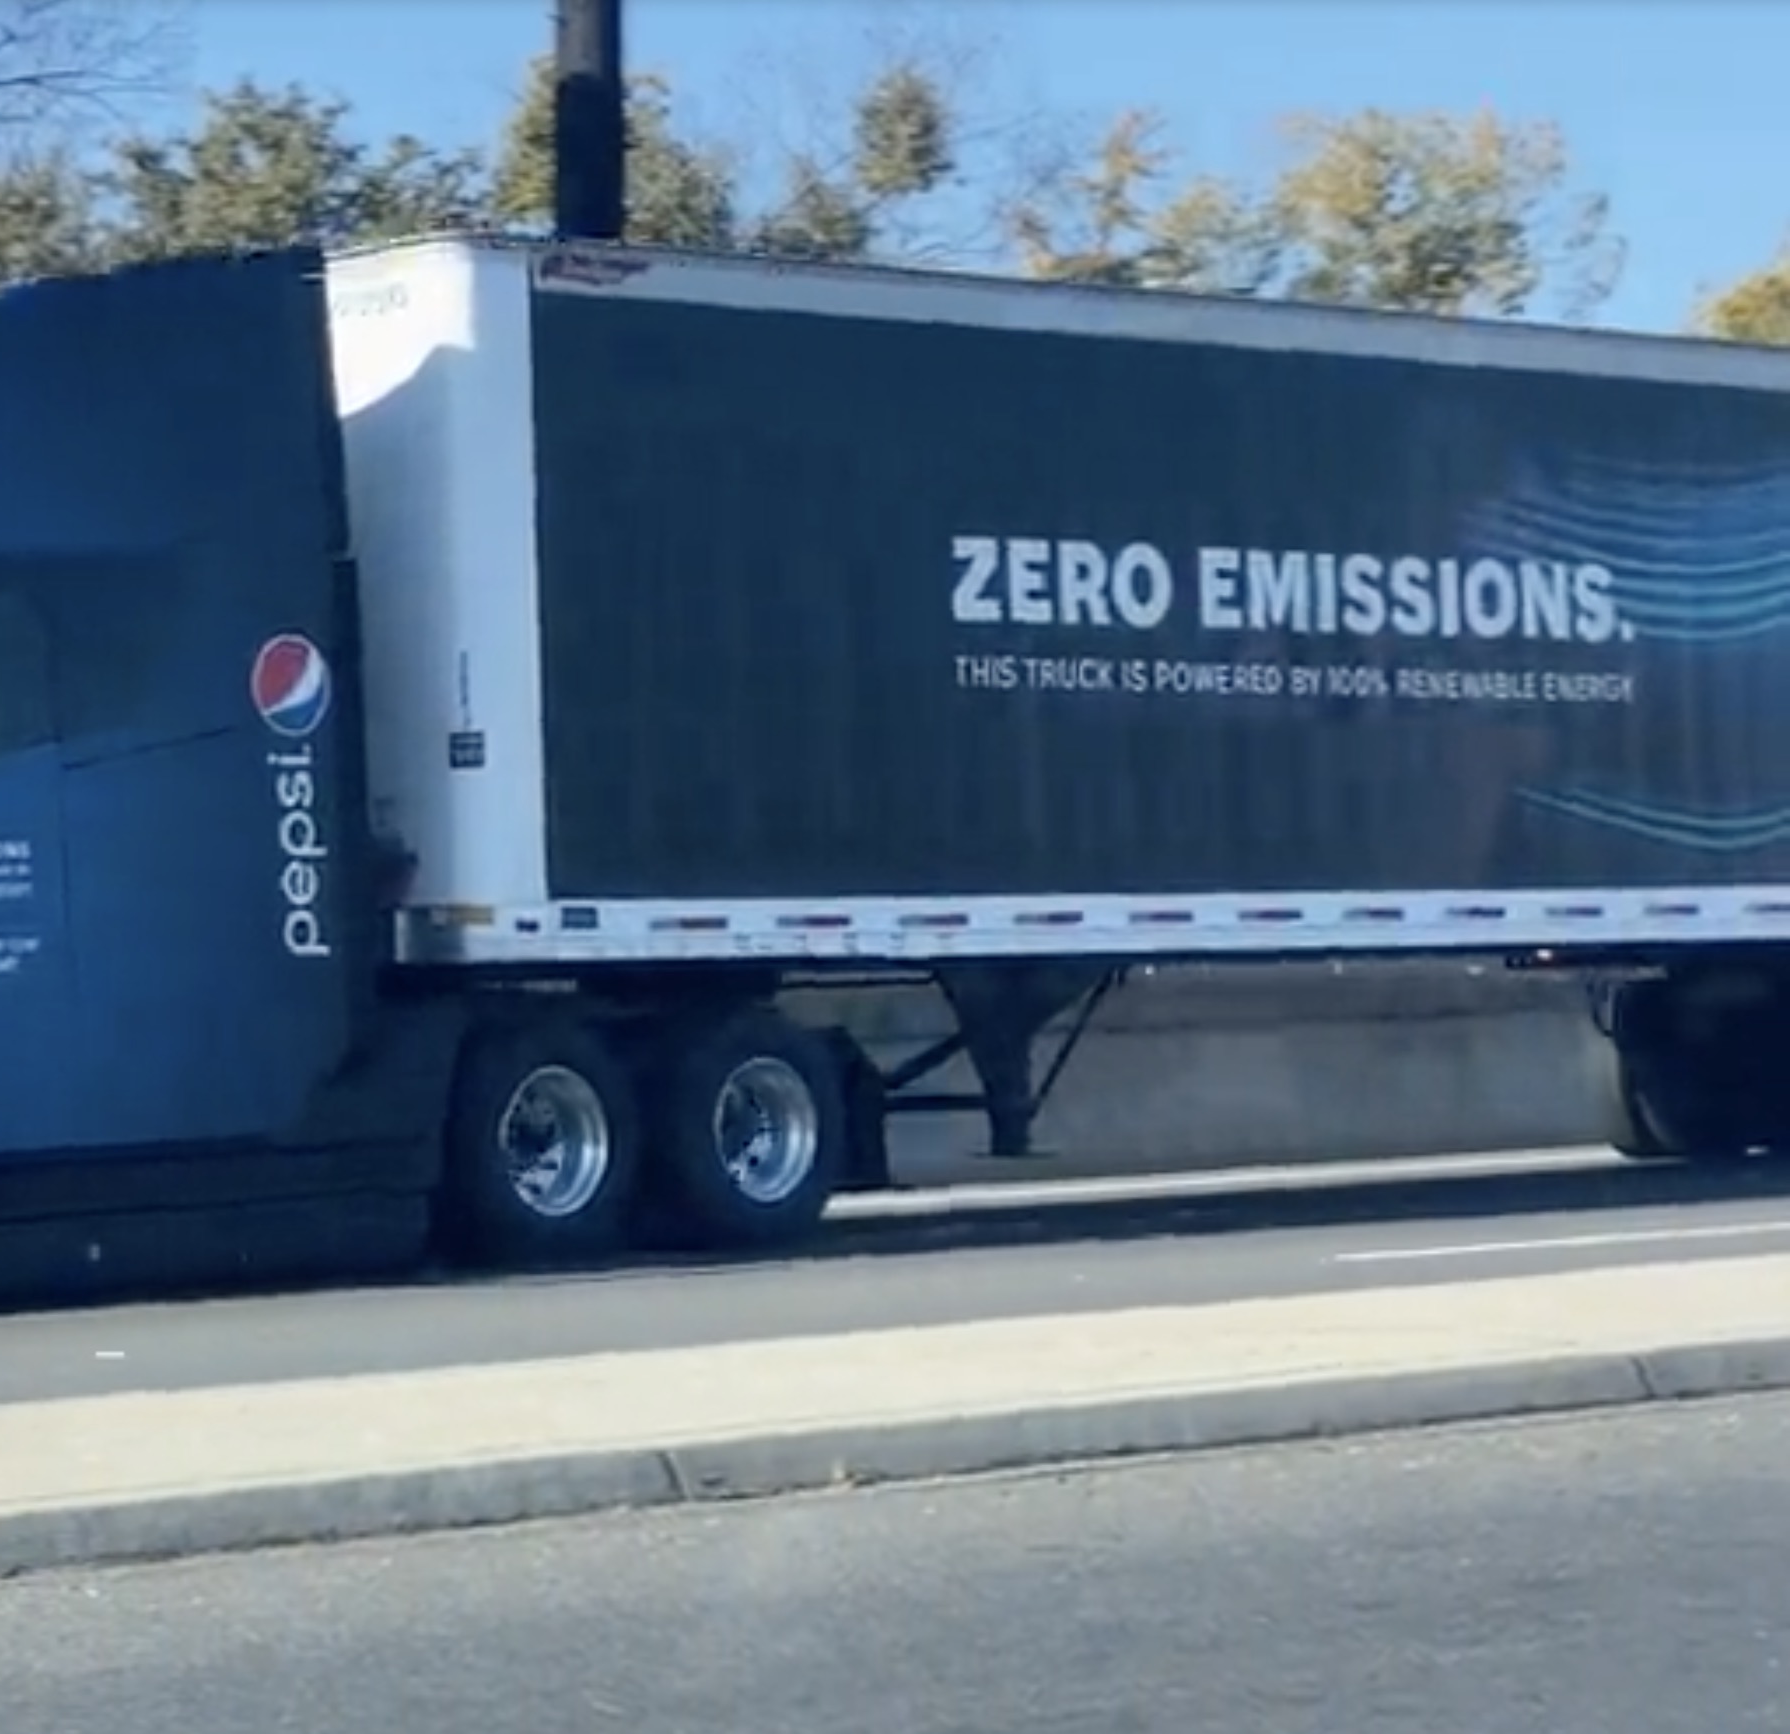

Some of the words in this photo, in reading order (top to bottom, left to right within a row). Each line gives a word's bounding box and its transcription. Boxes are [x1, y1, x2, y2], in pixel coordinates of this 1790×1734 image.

[951, 536, 1173, 628] ZERO
[1197, 546, 1636, 643] EMISSIONS.
[954, 655, 1018, 690] THIS
[1024, 657, 1114, 692] TRUCK
[1121, 659, 1148, 693] IS
[1154, 659, 1283, 695] POWERED
[1289, 664, 1322, 696] BY
[1328, 666, 1390, 698] 100%
[1396, 668, 1538, 702] RENEWABLE
[1542, 671, 1635, 704] ENERGY
[266, 752, 331, 956] pepsi
